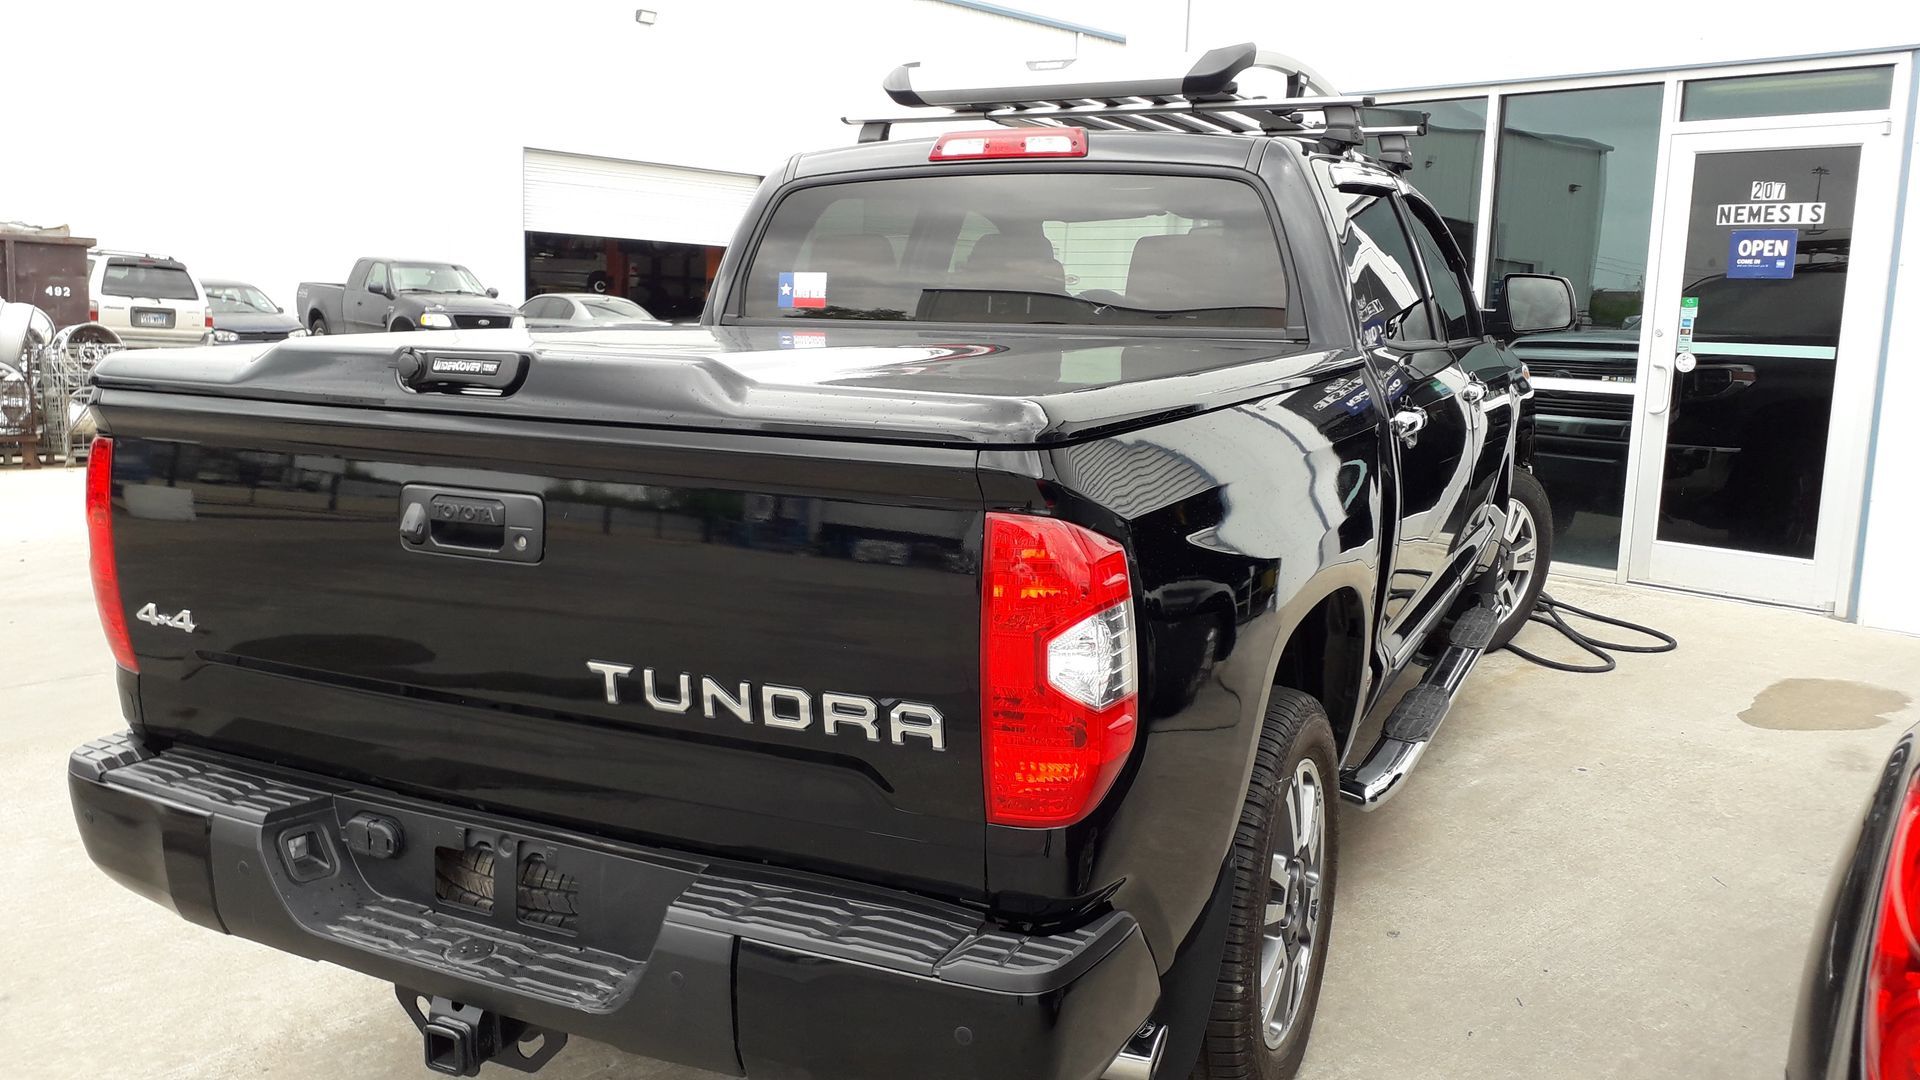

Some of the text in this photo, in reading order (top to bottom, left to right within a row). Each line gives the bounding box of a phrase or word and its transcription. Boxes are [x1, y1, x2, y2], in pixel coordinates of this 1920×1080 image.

[1753, 182, 1785, 199] 207
[1718, 204, 1823, 224] NEMESIS
[1737, 239, 1789, 257] OPEN
[45, 285, 71, 297] 492
[433, 502, 497, 523] TOYOTA
[586, 658, 946, 751] TUNDRA
